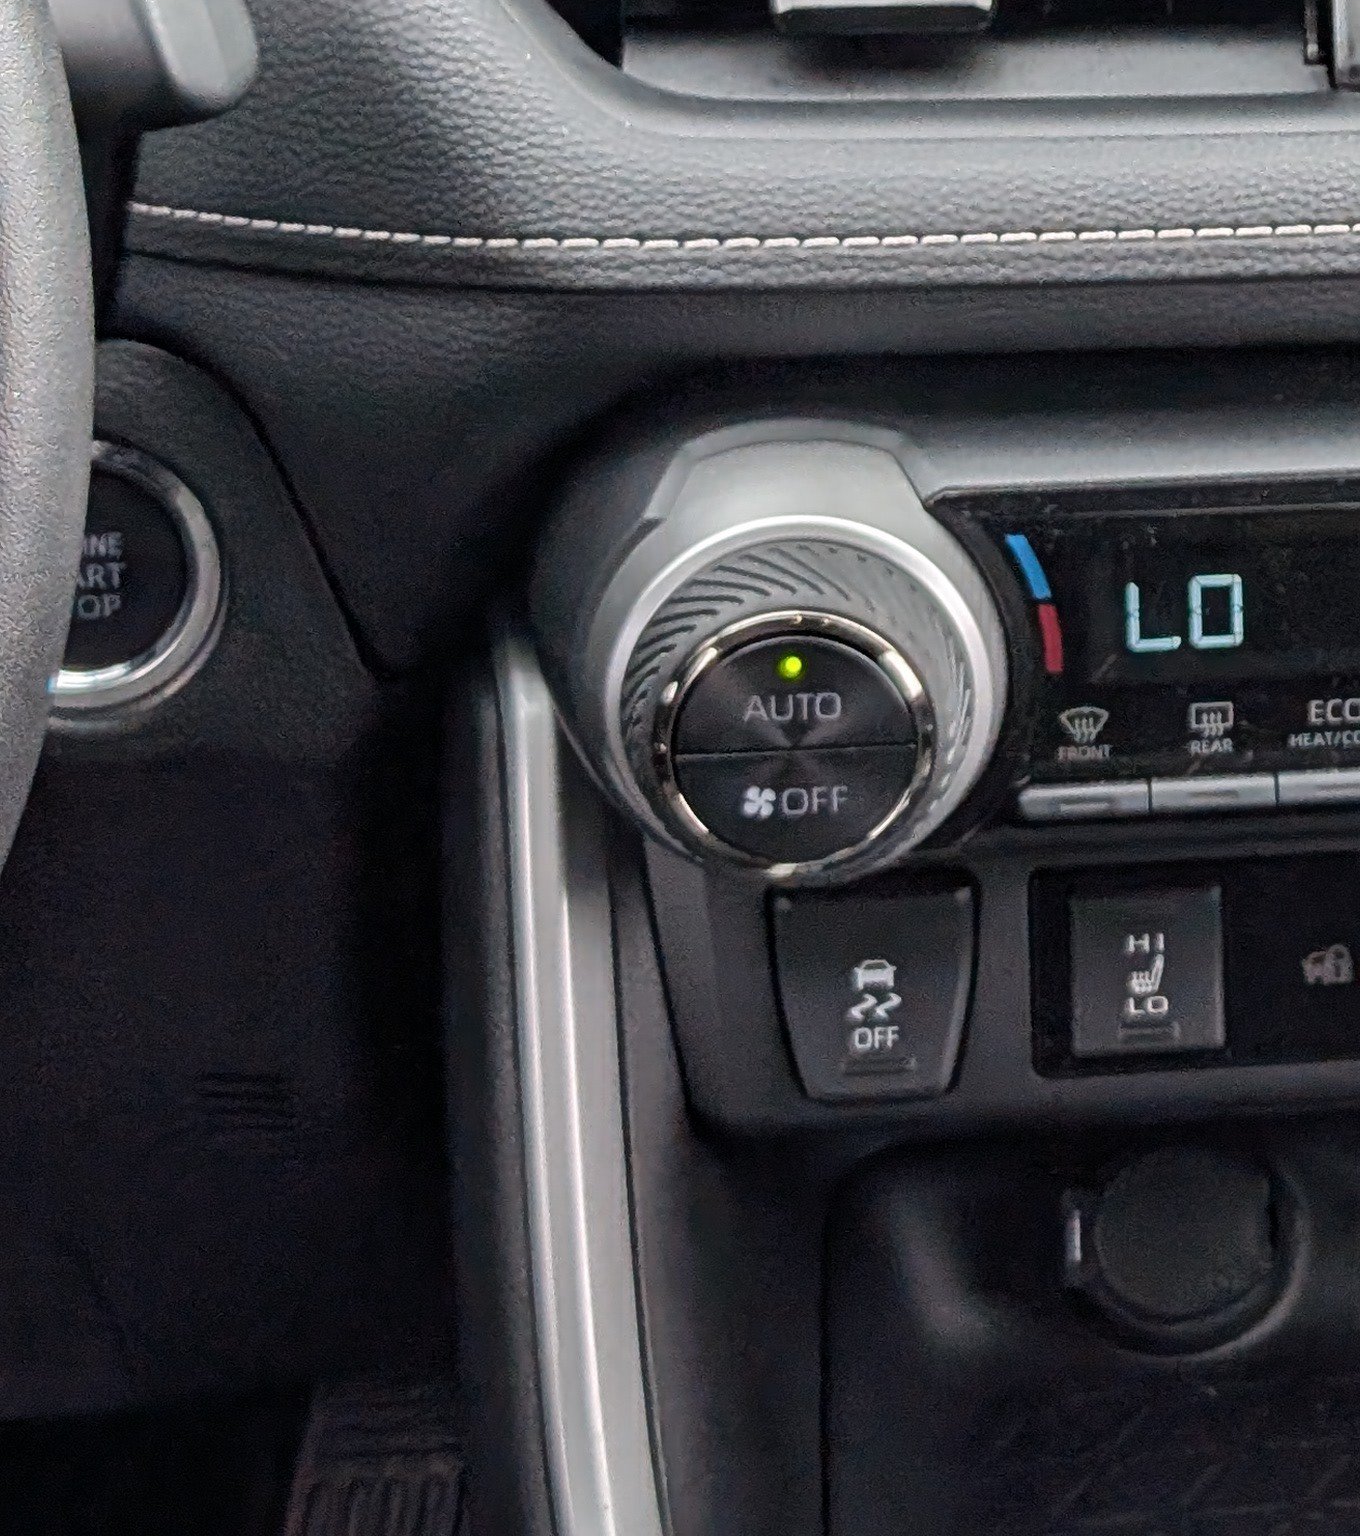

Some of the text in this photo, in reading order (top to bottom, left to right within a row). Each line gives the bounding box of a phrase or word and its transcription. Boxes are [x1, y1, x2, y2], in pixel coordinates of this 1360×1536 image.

[1125, 574, 1244, 652] LO
[742, 691, 842, 722] AUTO
[1058, 744, 1112, 762] FRONT
[1189, 738, 1234, 755] REAR
[781, 784, 849, 816] OFF
[1124, 932, 1165, 954] HI
[1125, 995, 1169, 1018] LO
[854, 1025, 899, 1051] OFF
